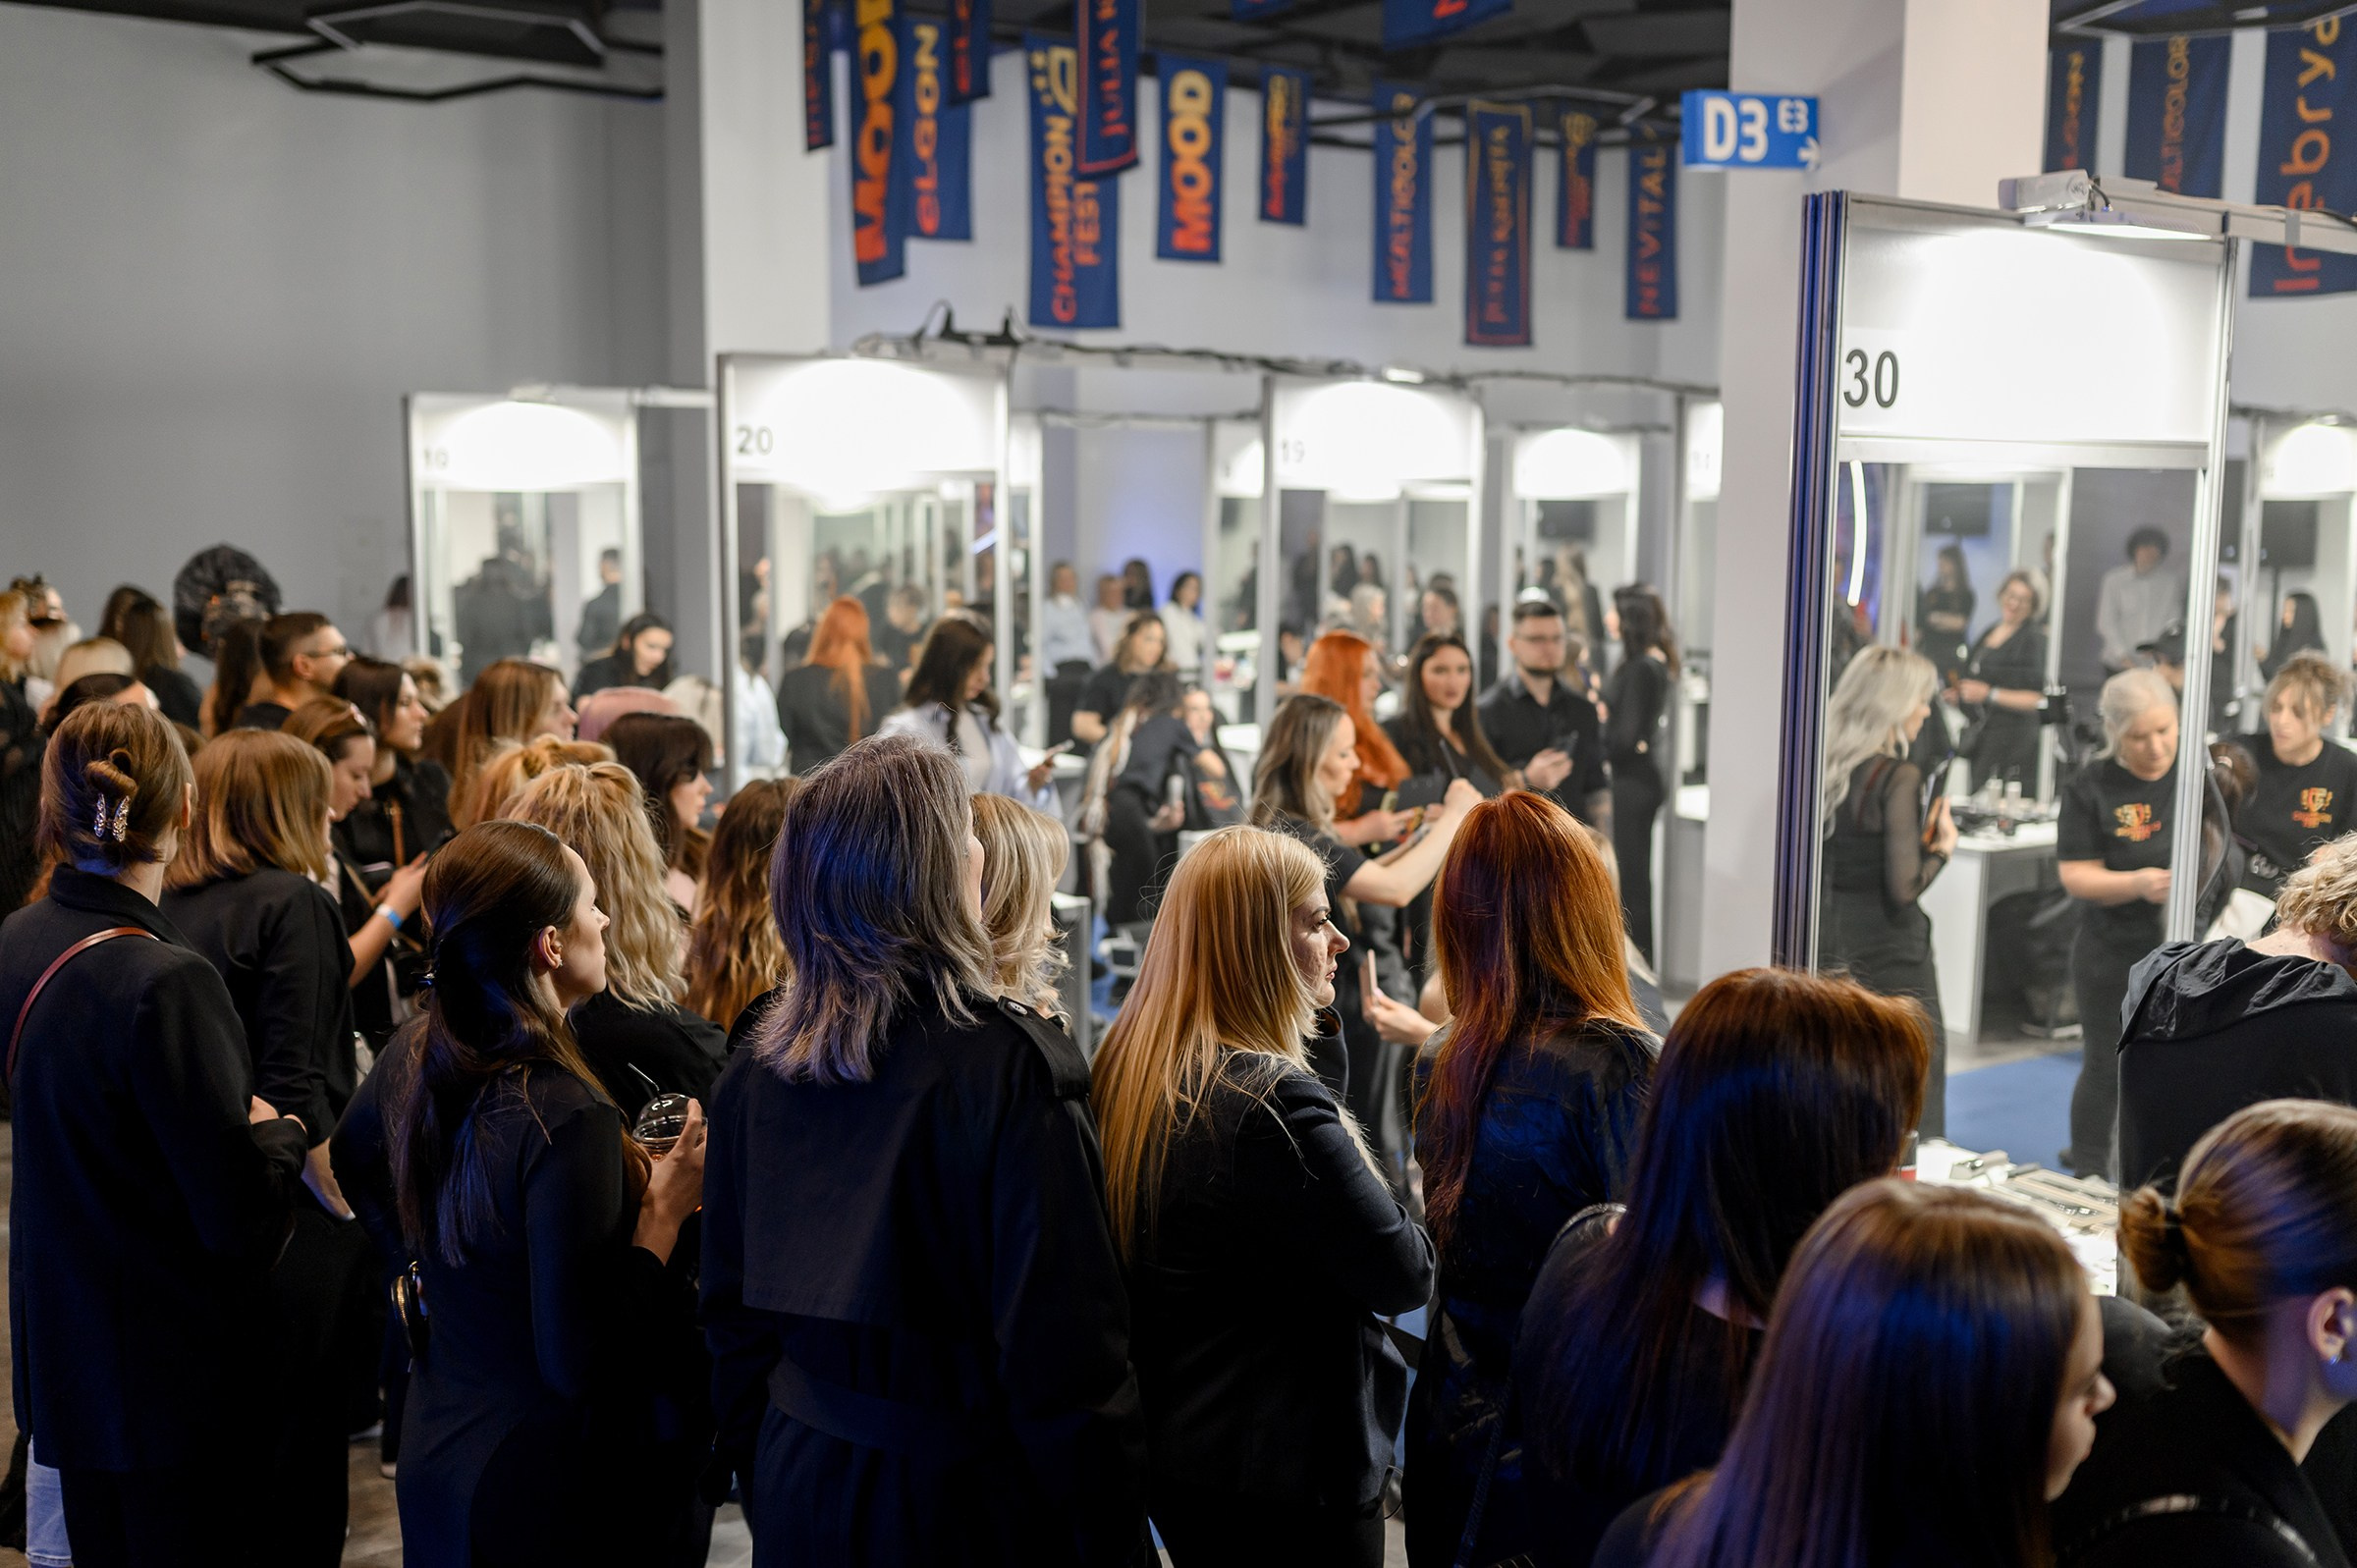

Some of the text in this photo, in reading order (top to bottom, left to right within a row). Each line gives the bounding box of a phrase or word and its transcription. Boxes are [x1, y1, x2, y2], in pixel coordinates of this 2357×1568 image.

[1168, 70, 1214, 253] MOOD
[1703, 96, 1769, 162] D3
[1043, 115, 1077, 323] CHAMPION
[1843, 349, 1899, 408] 30
[736, 424, 774, 457] 20
